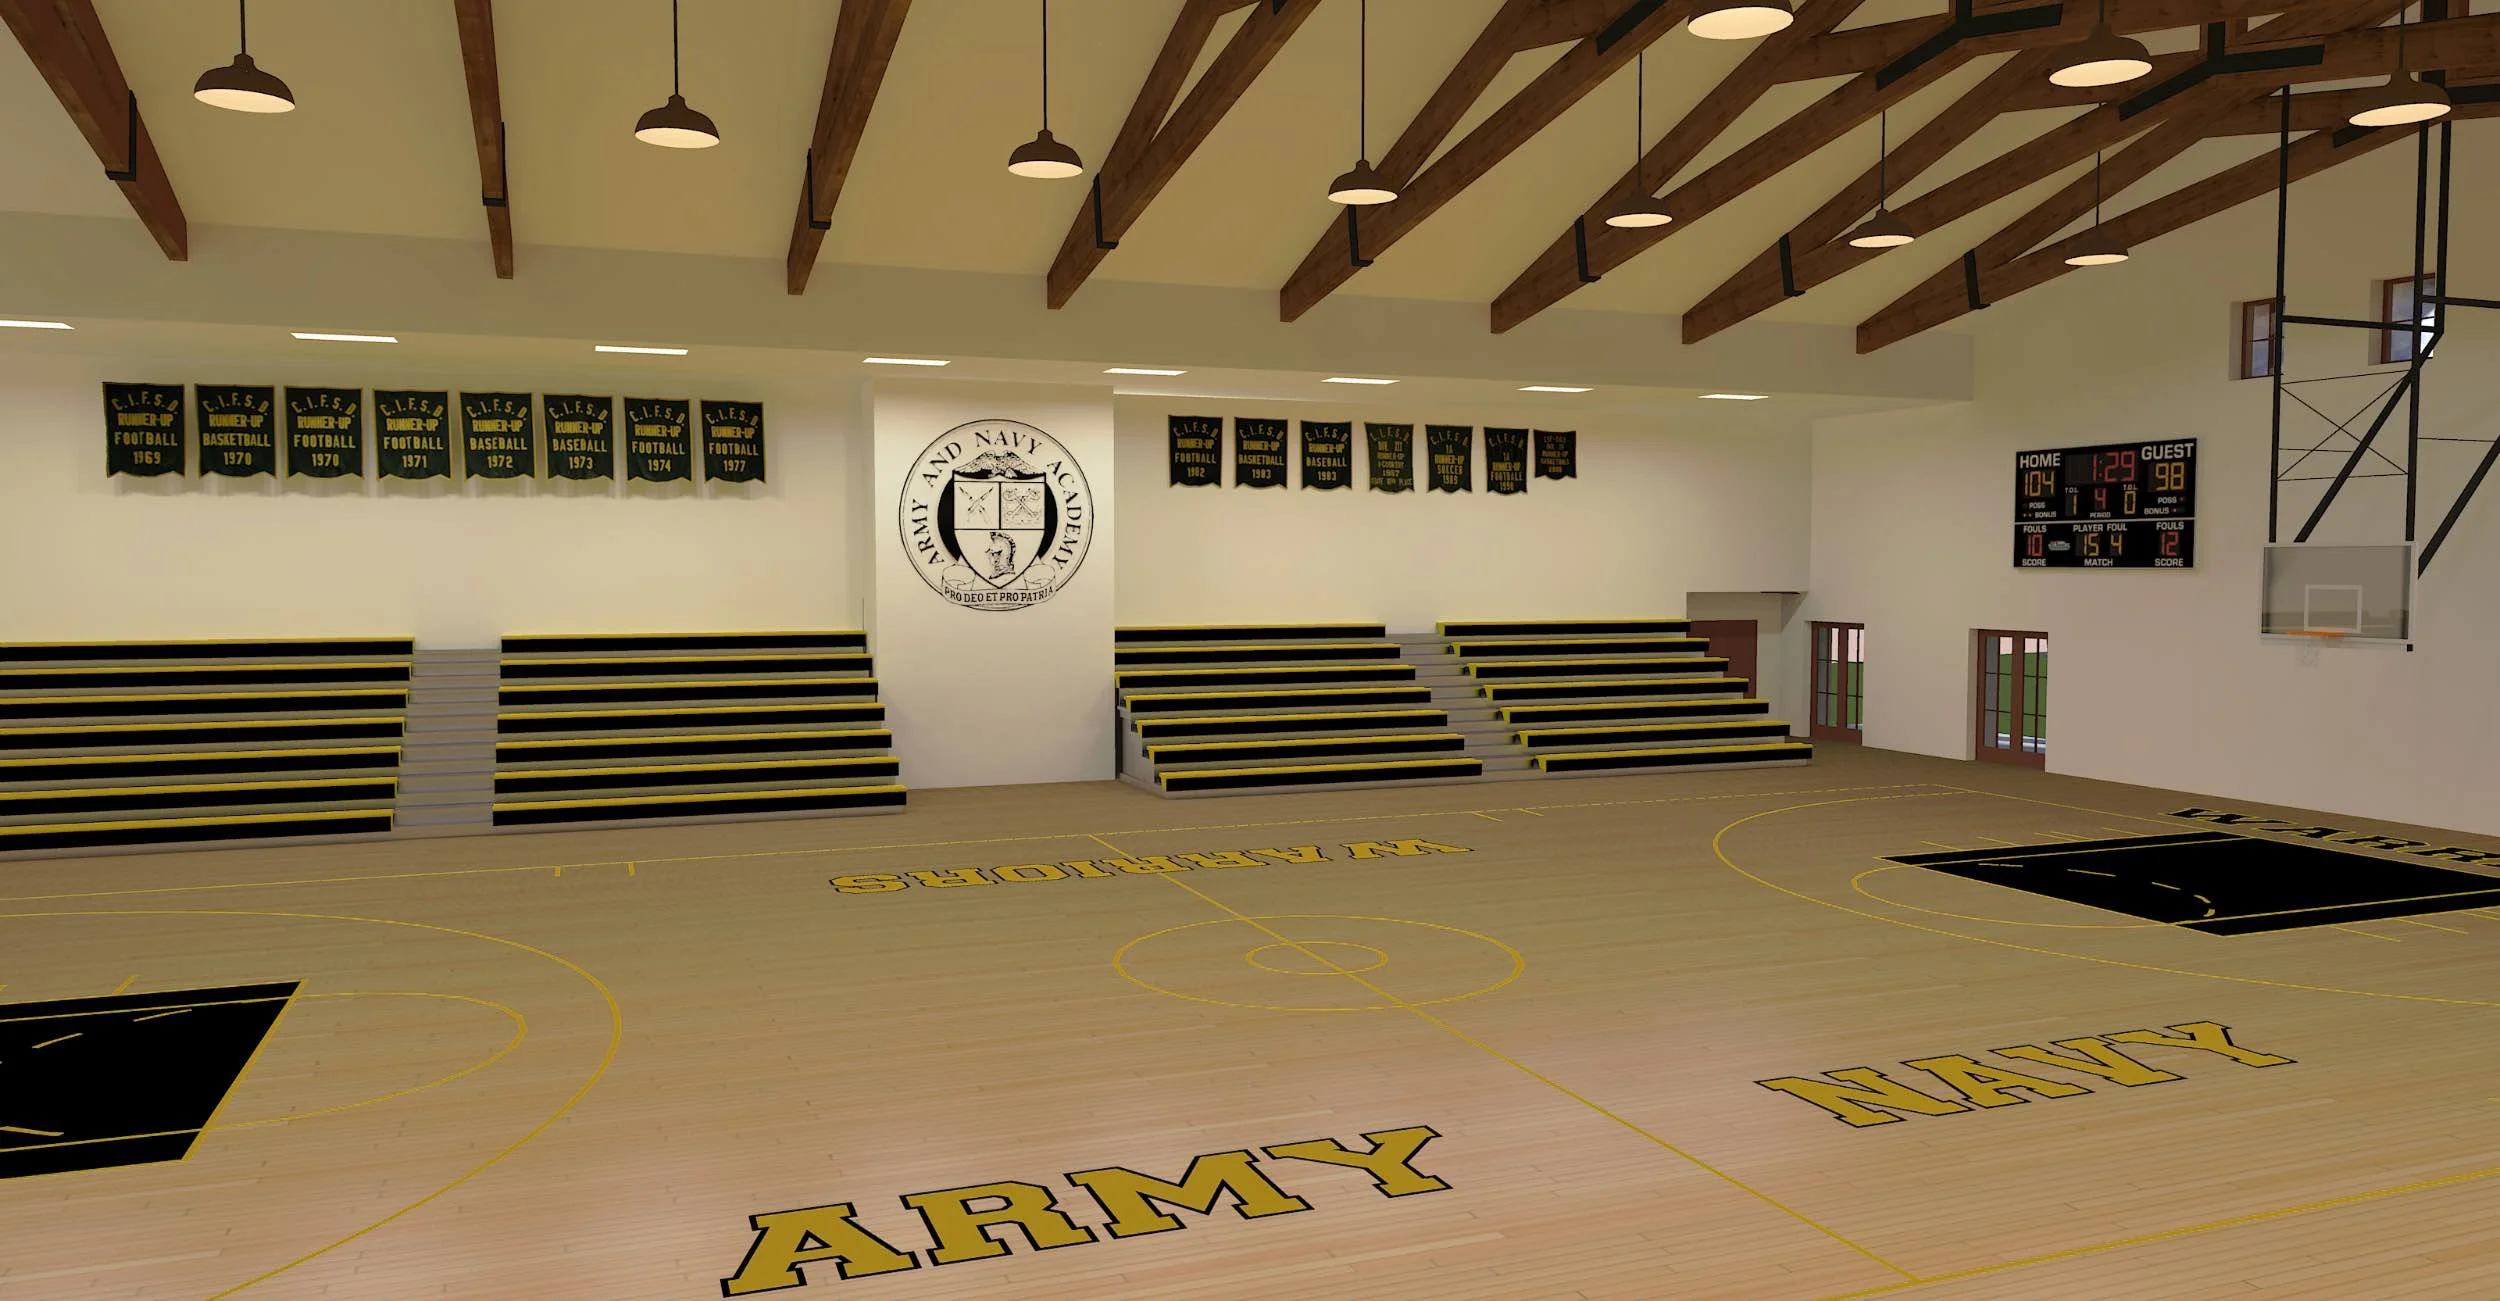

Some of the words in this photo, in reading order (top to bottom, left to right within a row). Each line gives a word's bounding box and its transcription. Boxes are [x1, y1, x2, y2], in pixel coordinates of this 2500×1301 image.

[118, 414, 174, 427] RUNNER-UP
[209, 414, 263, 428] RUNNER-UP
[297, 416, 350, 430] RUNNER-UP
[387, 418, 437, 431] RUNNER-UP
[472, 419, 522, 432] RUNNER-UP
[555, 420, 604, 434] RUNNER-UP
[635, 424, 681, 437] RUNNER-UP
[711, 426, 755, 438] RUNNER-UP
[115, 431, 177, 446] FOOTBALL
[203, 433, 271, 448] BASKETBALL
[294, 436, 356, 449] FOOTBALL
[383, 436, 443, 451] FOOTBALL
[470, 437, 527, 450] BASEBALL
[552, 438, 607, 453] BASEBALL
[975, 430, 1042, 455] NAVY
[632, 441, 685, 454] FOOTBALL
[709, 442, 758, 455] FOOTBALL
[2141, 443, 2194, 461] GUEST
[134, 451, 160, 464] 1969
[224, 452, 251, 466] 1970
[312, 454, 339, 467] 1970
[402, 455, 426, 468] 1971
[487, 456, 513, 468] 1972
[569, 456, 593, 469] 1973
[1175, 452, 1216, 463] FOOTBALL
[1239, 455, 1284, 466] BASKETBALL
[1306, 457, 1347, 467] BASEBALL
[2020, 453, 2060, 468] HOME
[648, 459, 671, 471] 1974
[723, 460, 746, 472] 1977
[922, 442, 962, 488] AND
[1437, 465, 1463, 475] SOCCER
[2092, 451, 2136, 482] 1:29
[2155, 462, 2185, 491] 98
[2024, 471, 2055, 497] 104
[2072, 495, 2077, 515] 1
[2094, 488, 2106, 509] 4
[2124, 491, 2136, 514] 0
[1046, 460, 1082, 570] ACADEMY
[2144, 507, 2169, 515] BONUS
[912, 499, 944, 565] ARMY
[2023, 525, 2047, 533] FOULS
[2073, 524, 2103, 532] PLAYER
[2107, 523, 2127, 531] FOUL
[2156, 522, 2184, 530] FOULS
[2027, 535, 2042, 556] 10
[2083, 534, 2099, 556] 15
[2110, 534, 2123, 555] 4
[2161, 532, 2179, 556] 12
[2022, 559, 2046, 567] SCORE
[2084, 559, 2113, 567] MATCH
[2155, 559, 2184, 567] SCORE
[945, 587, 962, 602] PRO
[964, 592, 983, 602] DEO
[986, 592, 998, 602] ET
[1000, 592, 1019, 602] PRO
[1020, 586, 1054, 602] PATRIA
[2159, 807, 2500, 868] WARR
[827, 837, 1475, 894] WARRIORS
[1753, 1020, 2298, 1129] NAVY
[720, 1125, 1454, 1299] ARMY
